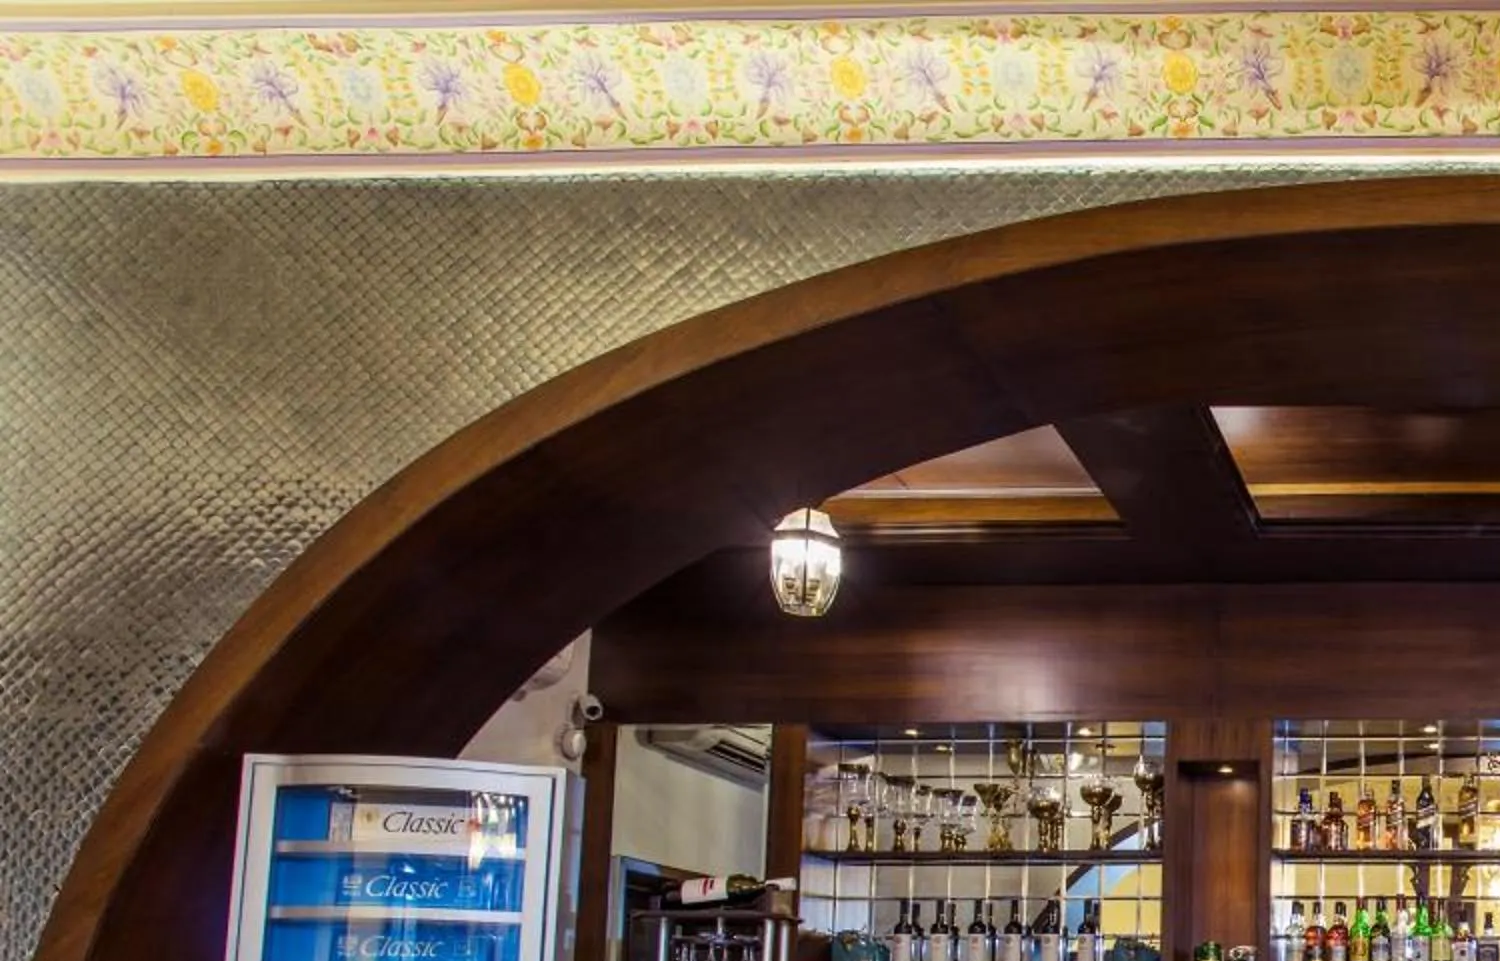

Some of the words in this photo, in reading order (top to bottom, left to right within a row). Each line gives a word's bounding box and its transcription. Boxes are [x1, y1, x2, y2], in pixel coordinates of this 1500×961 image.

[383, 811, 465, 835] Classic
[365, 874, 449, 899] Classic
[359, 934, 445, 958] Classic
